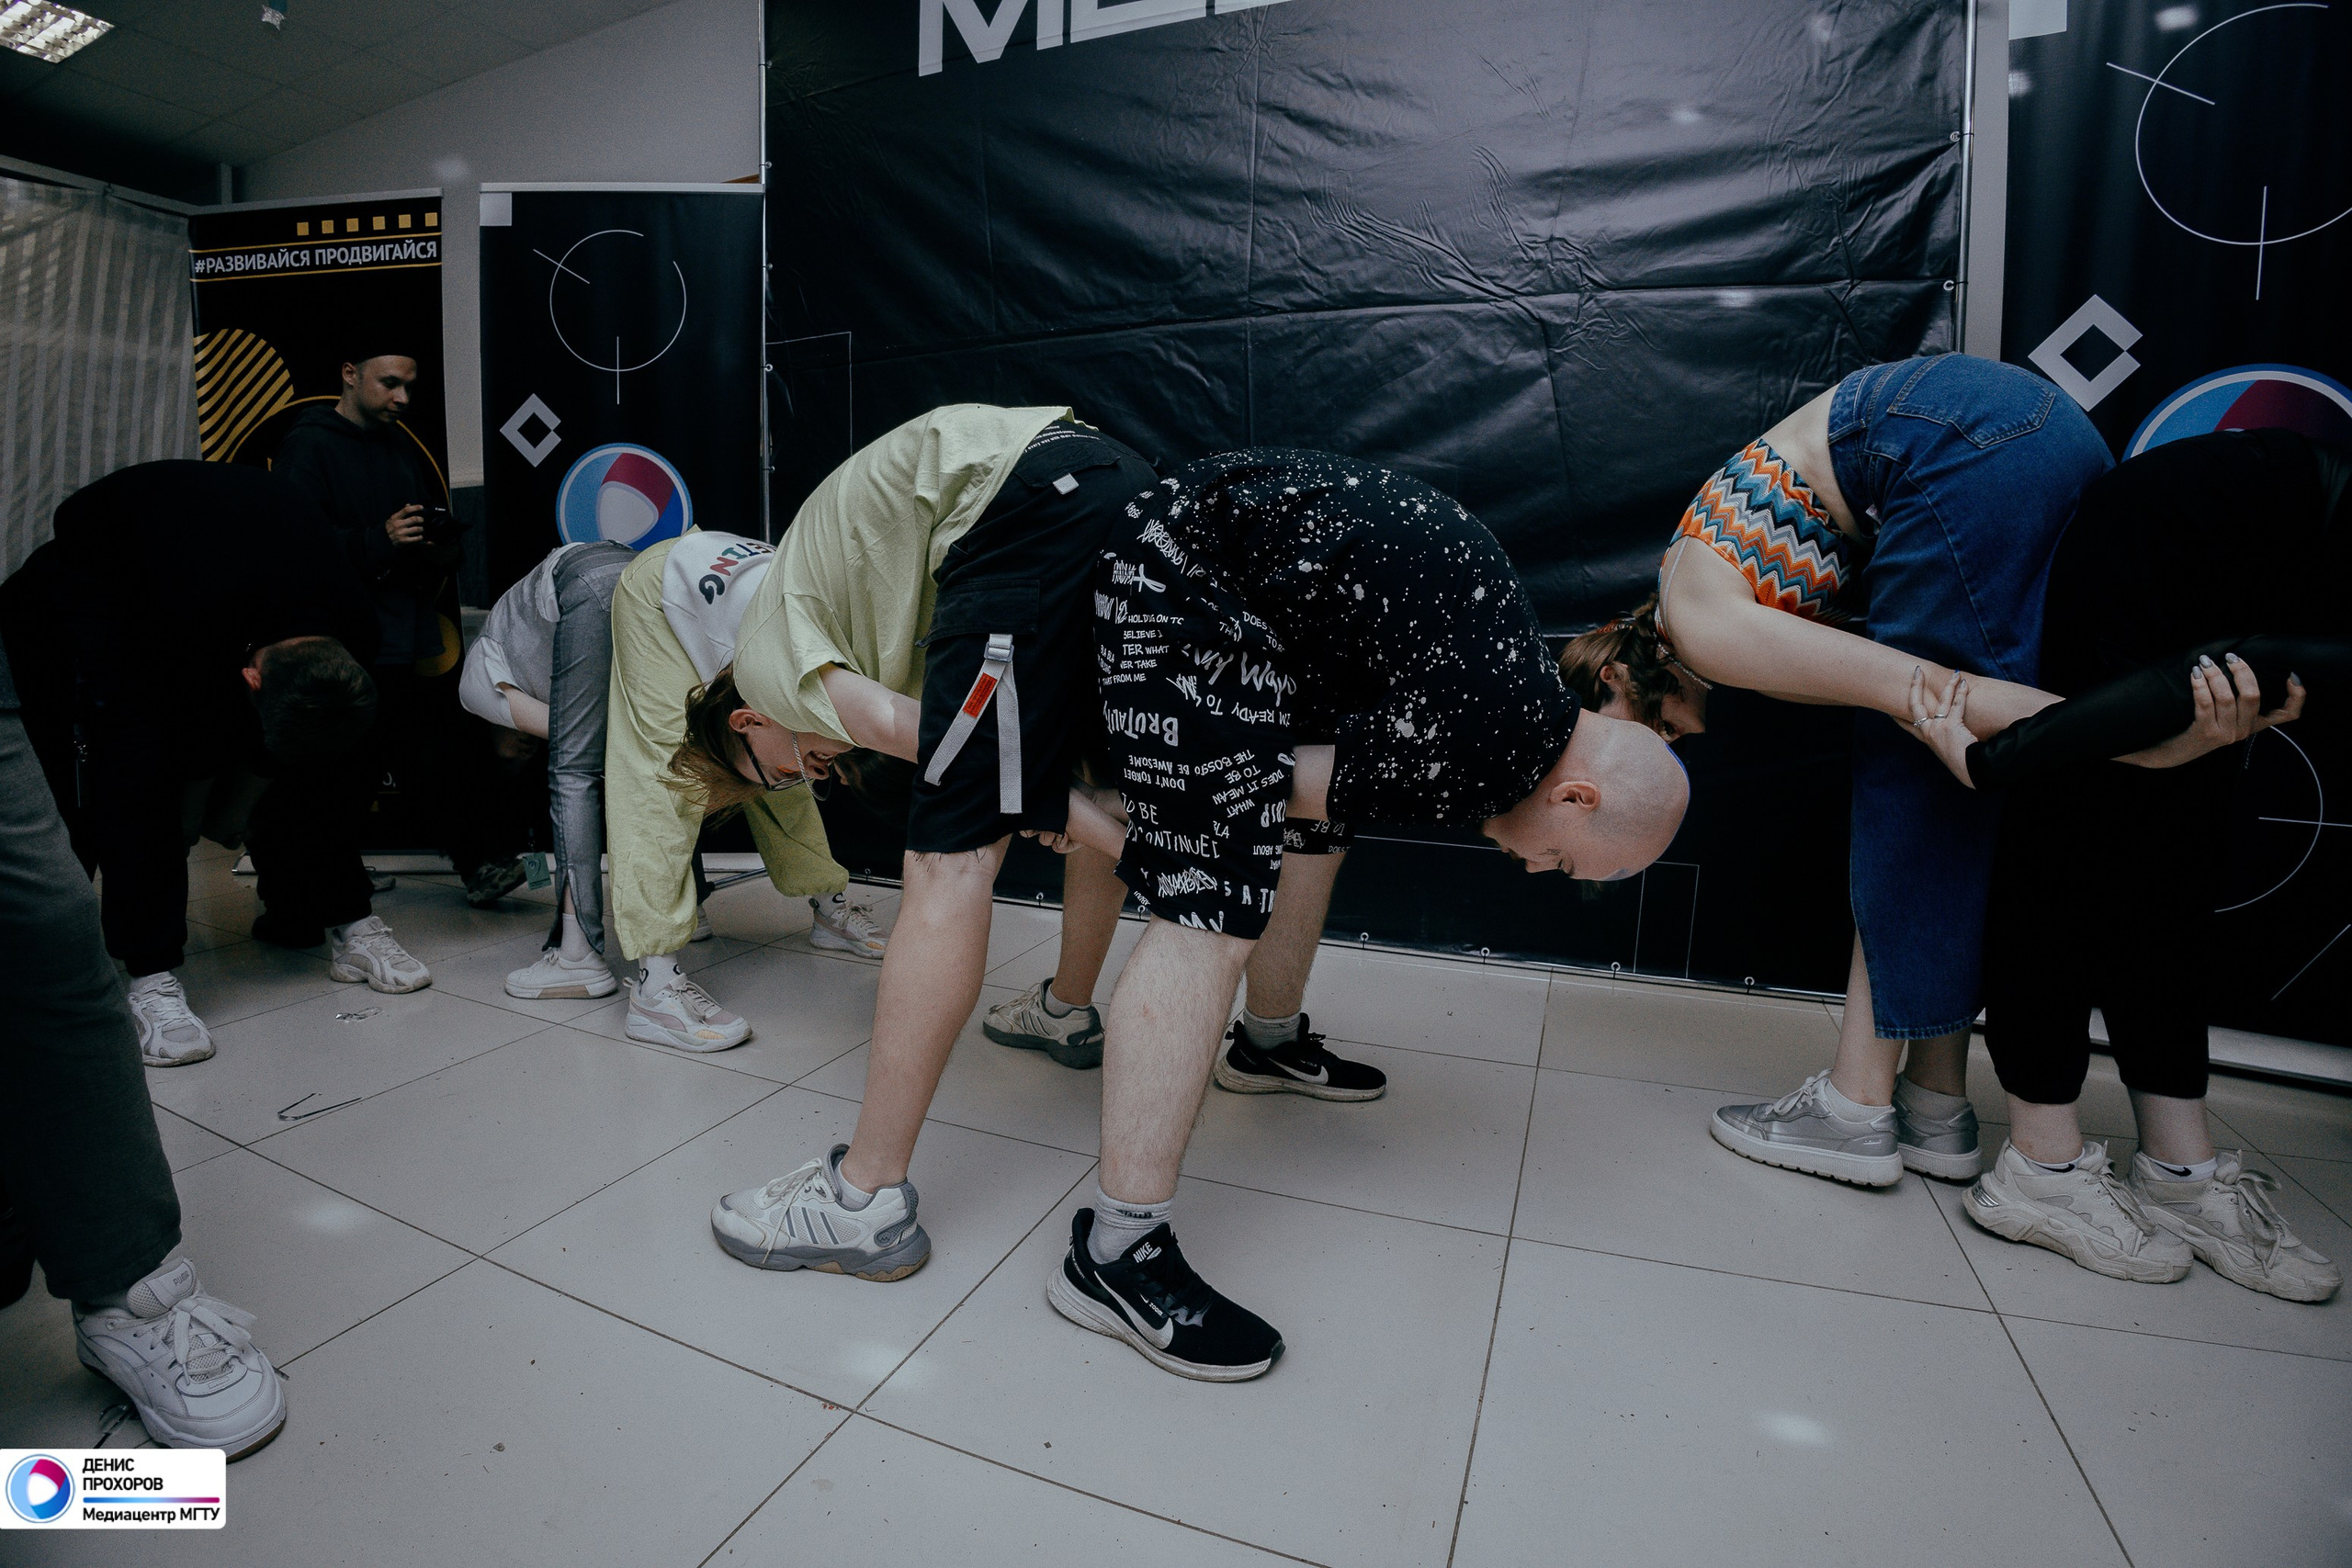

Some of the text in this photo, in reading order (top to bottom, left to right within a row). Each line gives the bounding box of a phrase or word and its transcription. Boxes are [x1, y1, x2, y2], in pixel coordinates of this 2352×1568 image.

[195, 239, 437, 274] #РАЗВИВАЙСЯ ПРОДВИГАЙСЯ
[1156, 614, 1169, 624] ON
[1242, 611, 1268, 630] DOES
[1145, 645, 1170, 655] WHAT
[1134, 659, 1158, 669] TAKE
[1113, 673, 1133, 683] FROM
[1133, 672, 1147, 682] ME
[1206, 694, 1224, 716] TO
[1231, 702, 1274, 725] READY
[1128, 754, 1173, 775] AWESOME
[1233, 749, 1255, 764] THE
[1177, 763, 1190, 775] BE
[1224, 764, 1261, 784] TO BE
[1124, 768, 1185, 791] DON'T FORGET
[1212, 769, 1285, 806] DOES IT MEAN
[1122, 792, 1159, 825] TO BE
[1226, 798, 1256, 818] WHAT
[1252, 845, 1274, 856] ABOUT
[1241, 885, 1252, 906] A
[1132, 1241, 1154, 1264] NIKE
